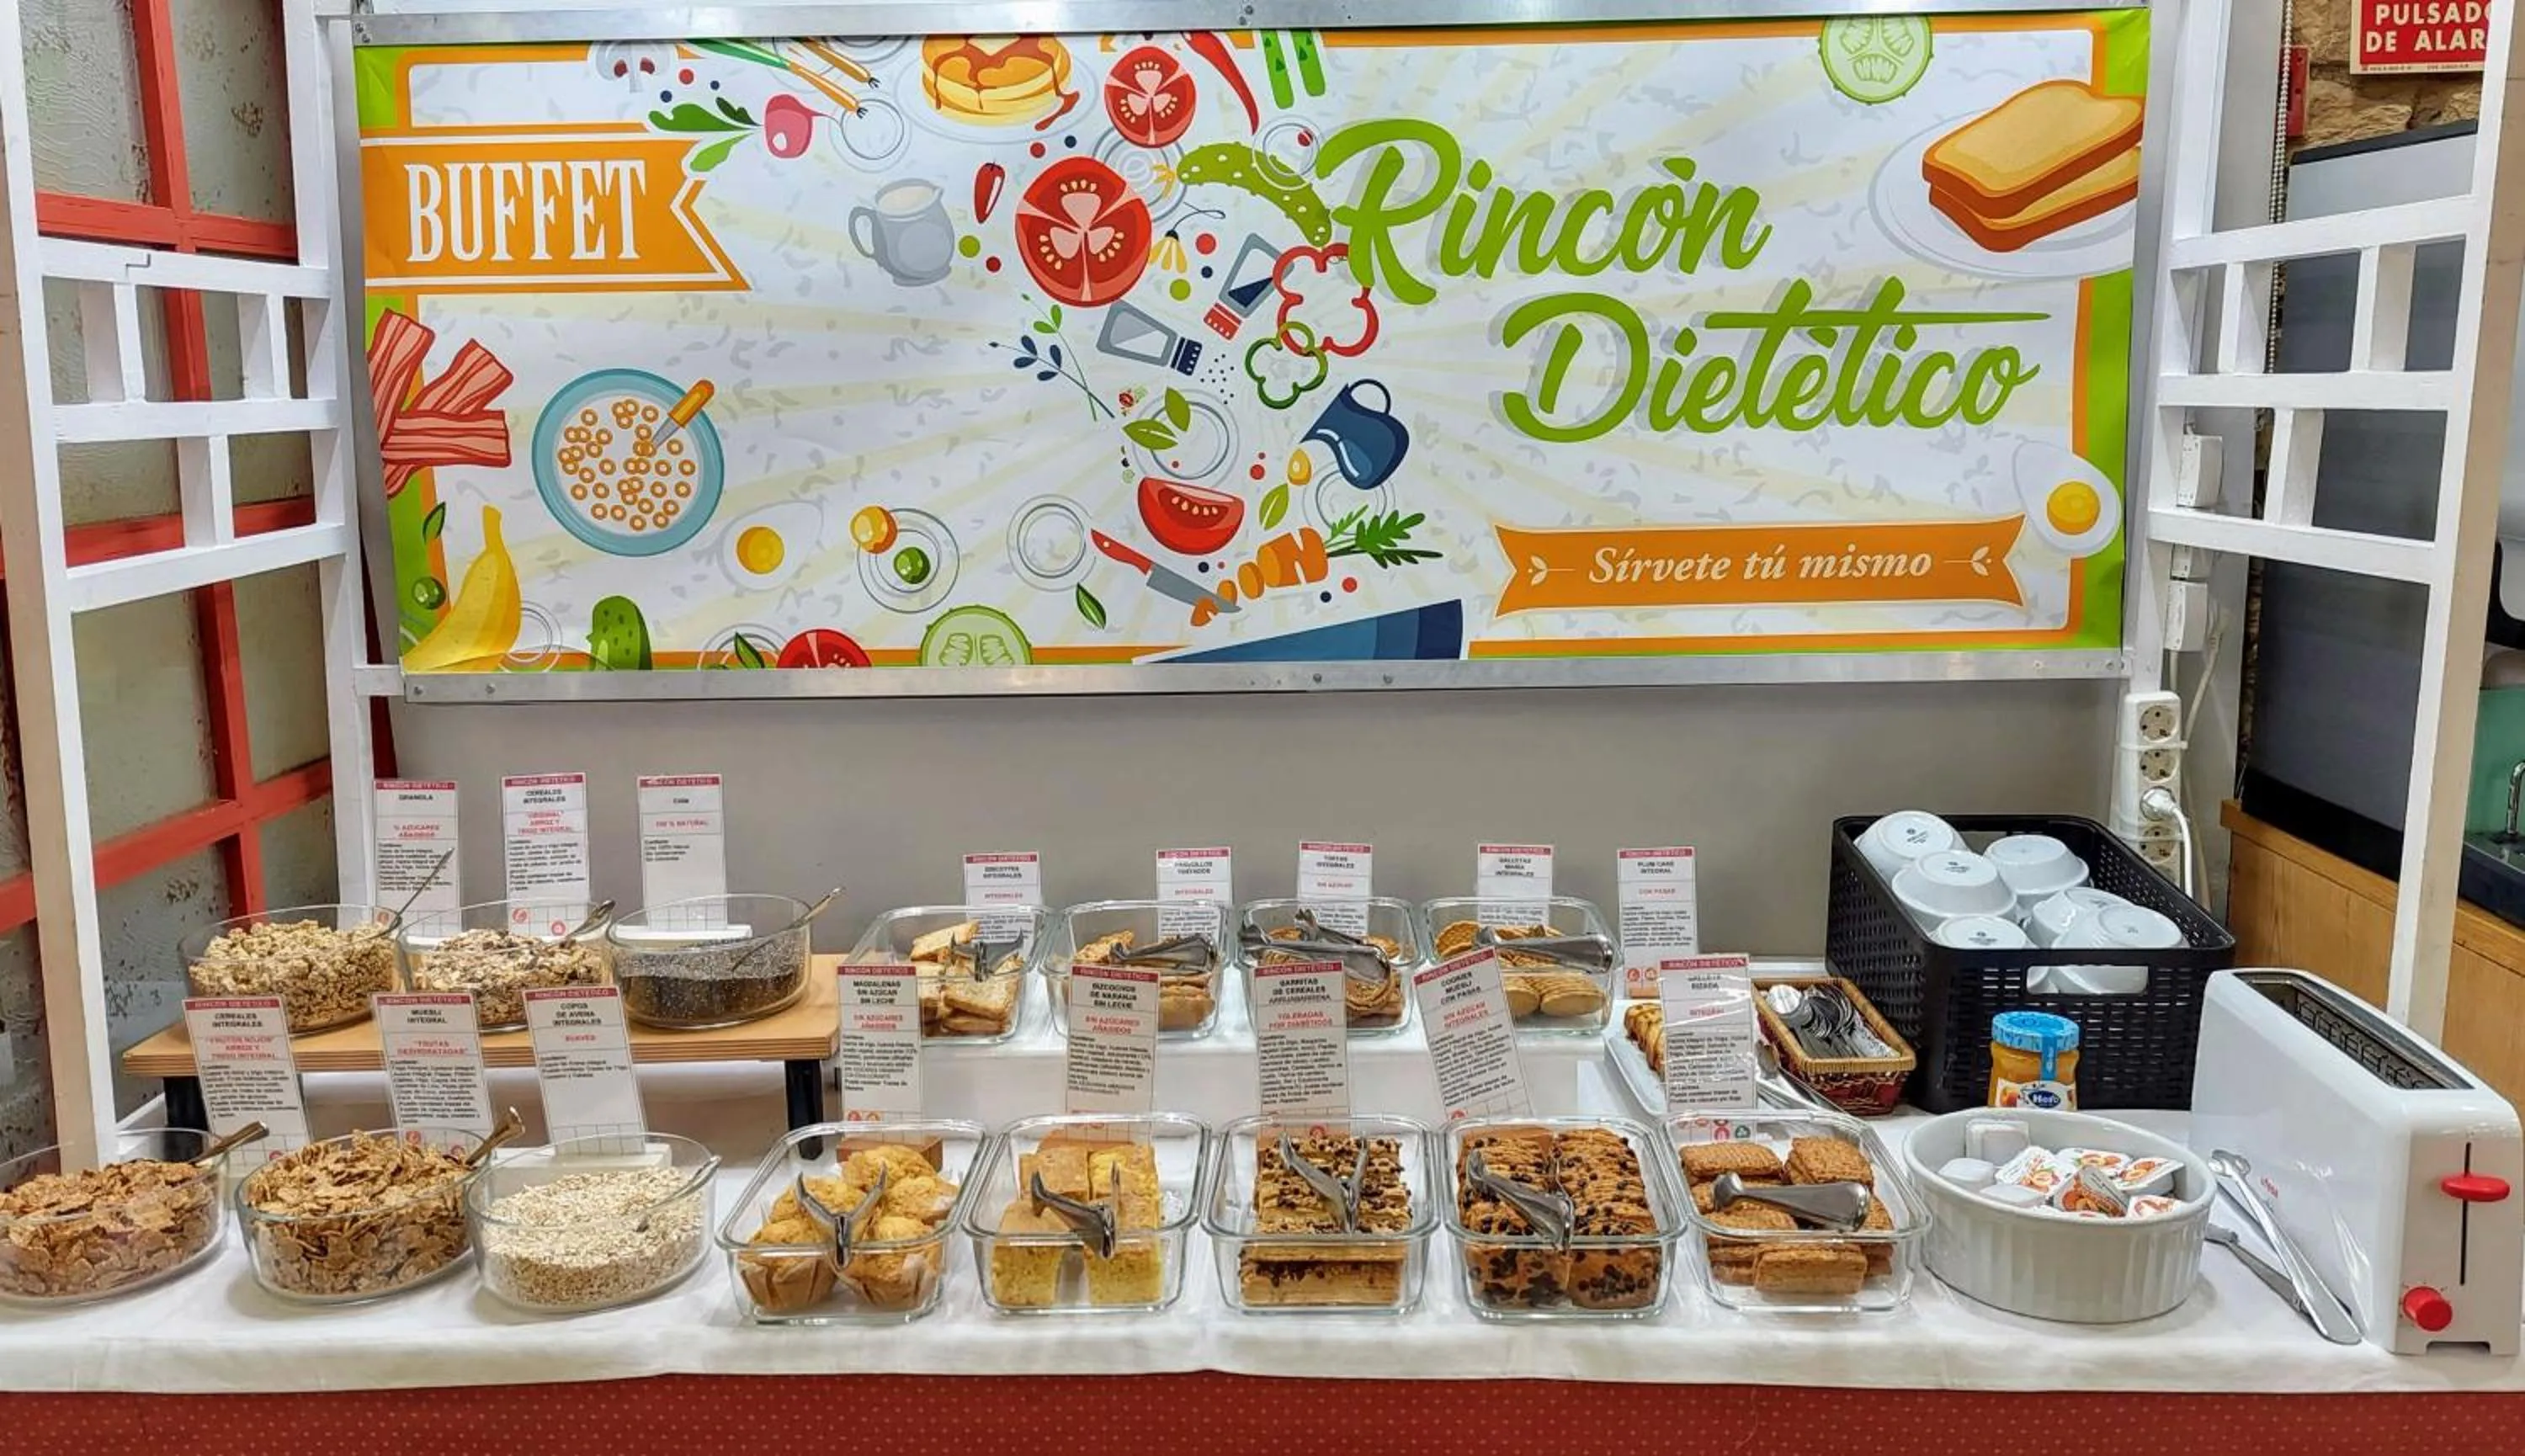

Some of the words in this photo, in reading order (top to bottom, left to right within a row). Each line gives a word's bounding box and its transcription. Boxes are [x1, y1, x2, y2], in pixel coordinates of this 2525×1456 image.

[2366, 30, 2397, 52] DE
[404, 160, 646, 262] BUFFET
[1589, 547, 1731, 584] Sírvete
[1744, 544, 1787, 580] tú
[1799, 543, 1932, 579] mismo
[1092, 983, 1136, 992] BIZCOCHOS
[1285, 986, 1326, 995] CEREALES
[1102, 992, 1137, 1001] NARANJA
[552, 1018, 602, 1027] INTEGRALES
[2033, 1094, 2059, 1103] Hero
